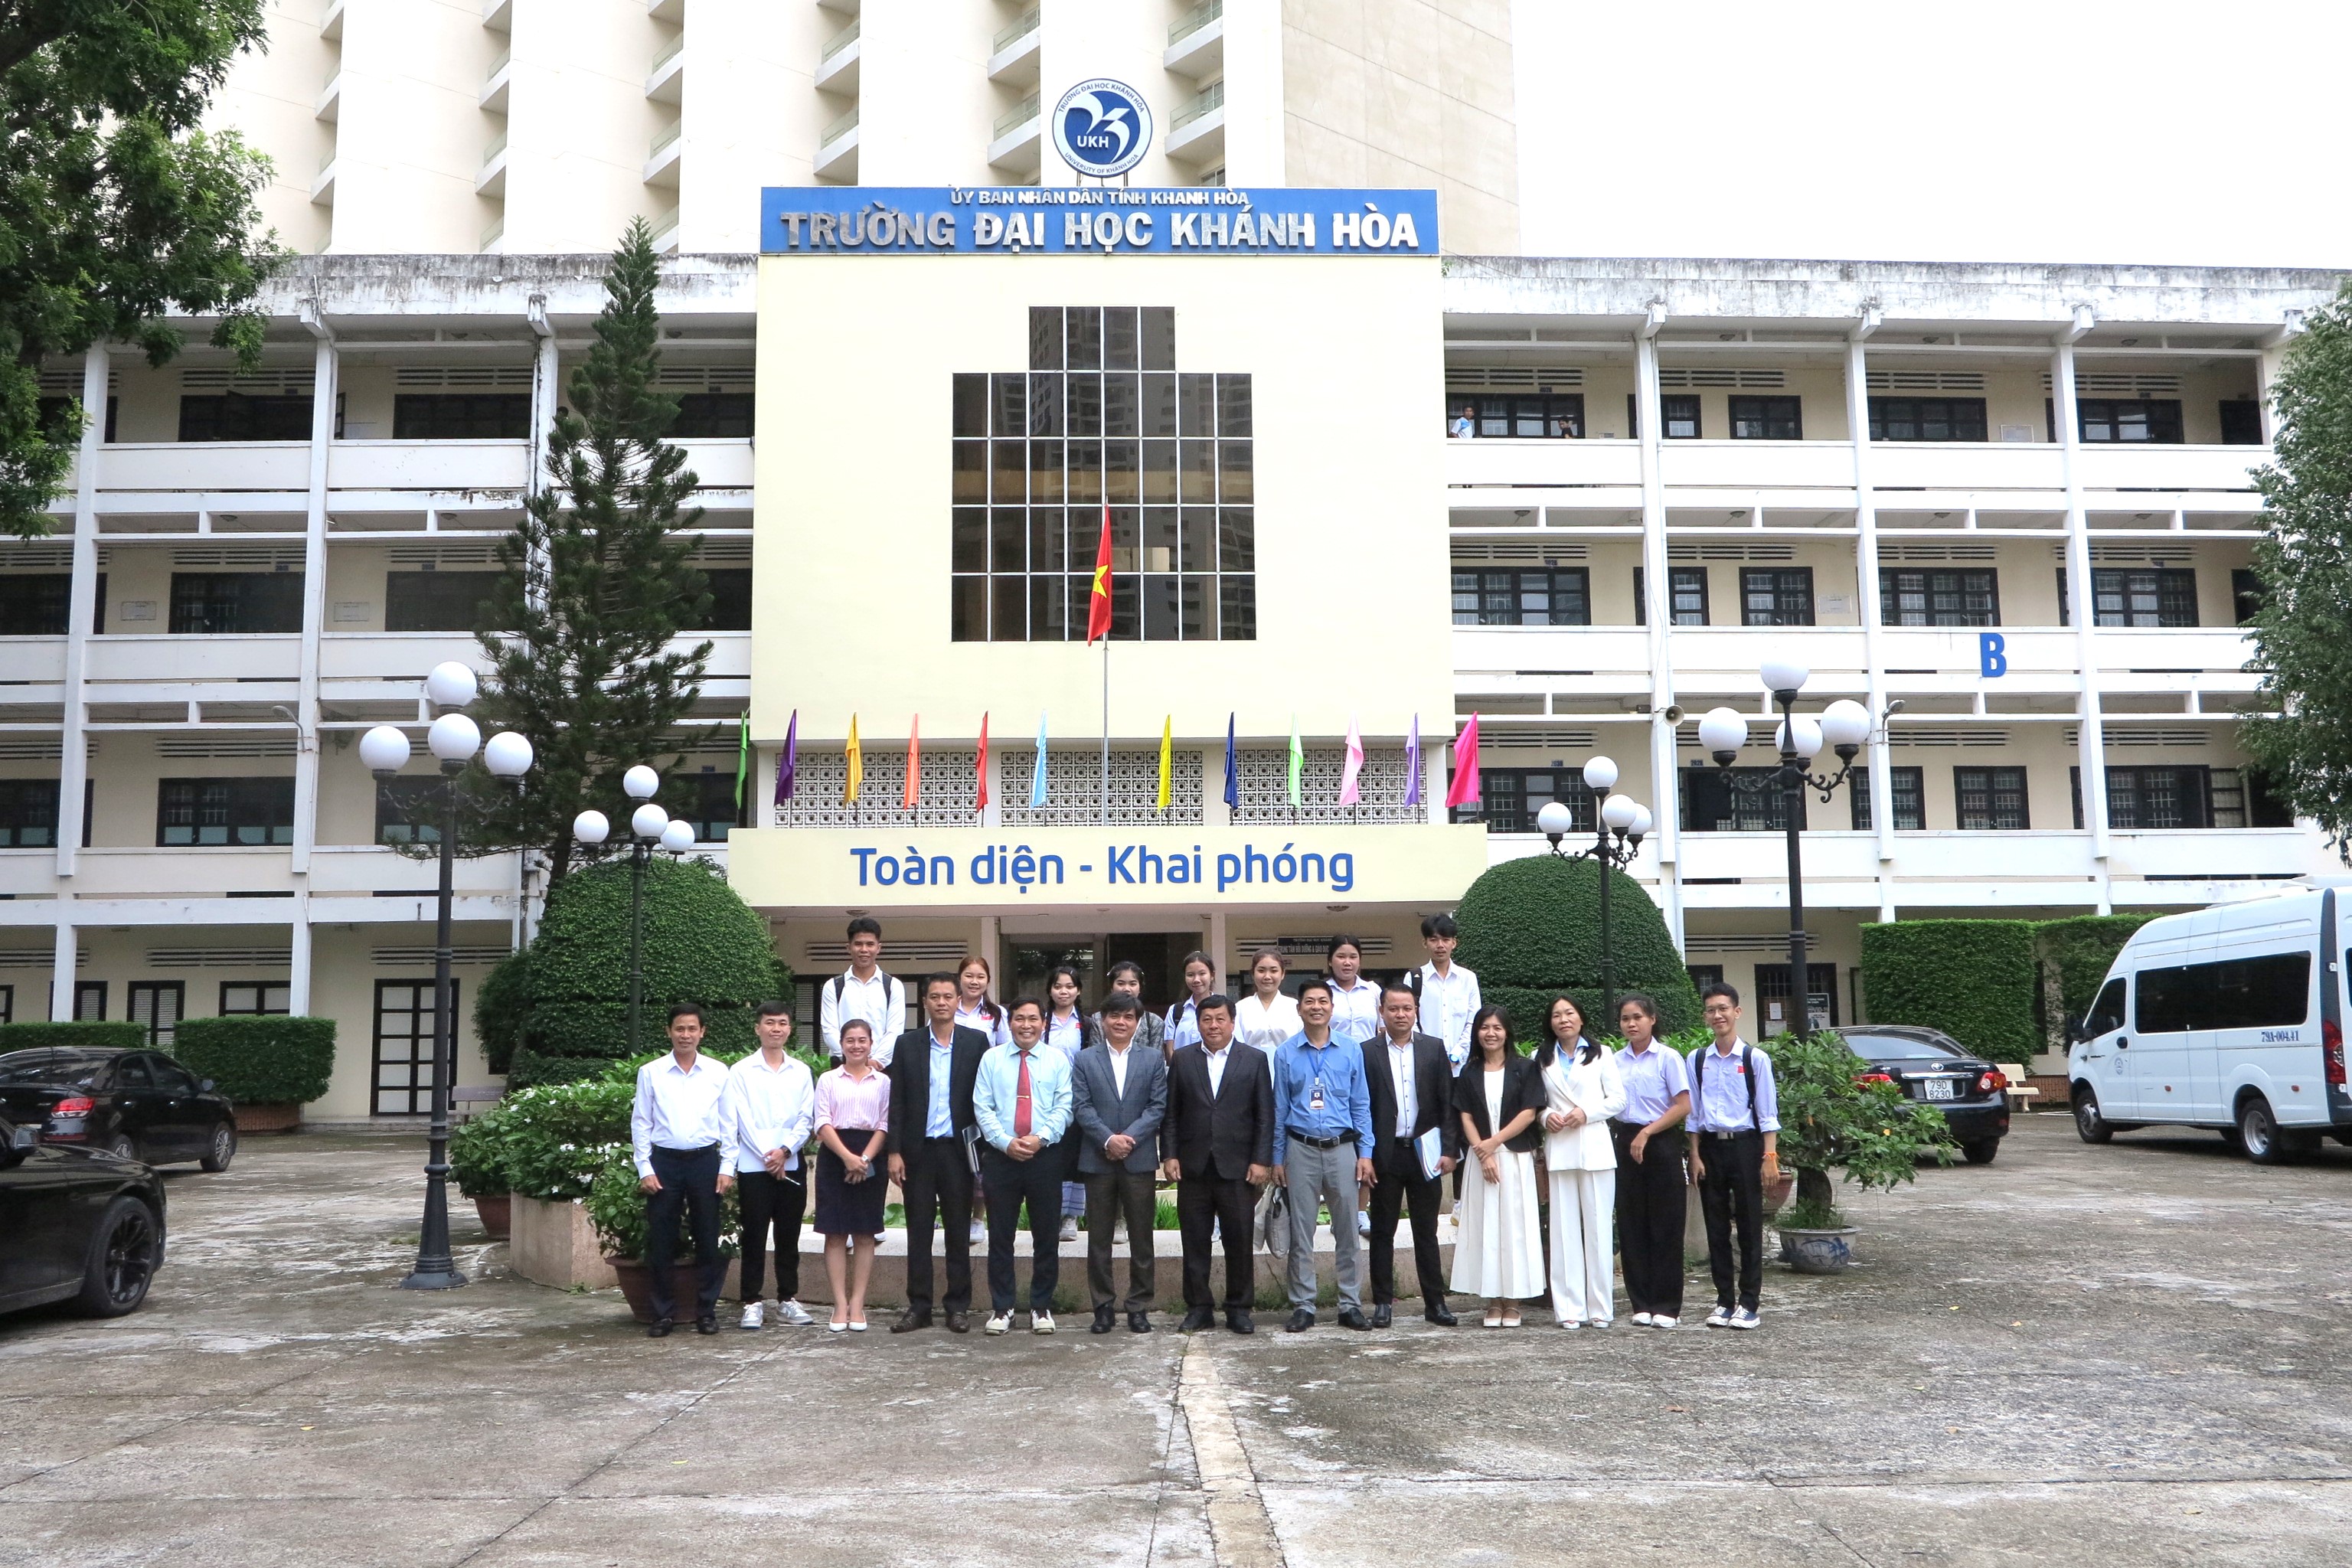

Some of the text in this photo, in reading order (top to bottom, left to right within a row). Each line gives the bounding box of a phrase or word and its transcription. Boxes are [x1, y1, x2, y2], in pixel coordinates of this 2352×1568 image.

[1076, 136, 1109, 149] UKH
[1065, 152, 1096, 173] UNIVERSITY
[1106, 162, 1128, 174] KHANH
[978, 191, 1014, 204] BAN
[1018, 188, 1066, 204] NHÂN
[1068, 188, 1103, 204] DÂN
[1214, 188, 1250, 205] HÒA
[780, 201, 1419, 255] TRƯỜNG ĐẠI HỌC KHÁNH HÒA
[1979, 632, 2007, 678] B
[849, 843, 1354, 894] Toàn diện - Khai phóng
[1929, 1089, 1951, 1099] 8230
[1930, 1080, 1948, 1089] 79D
